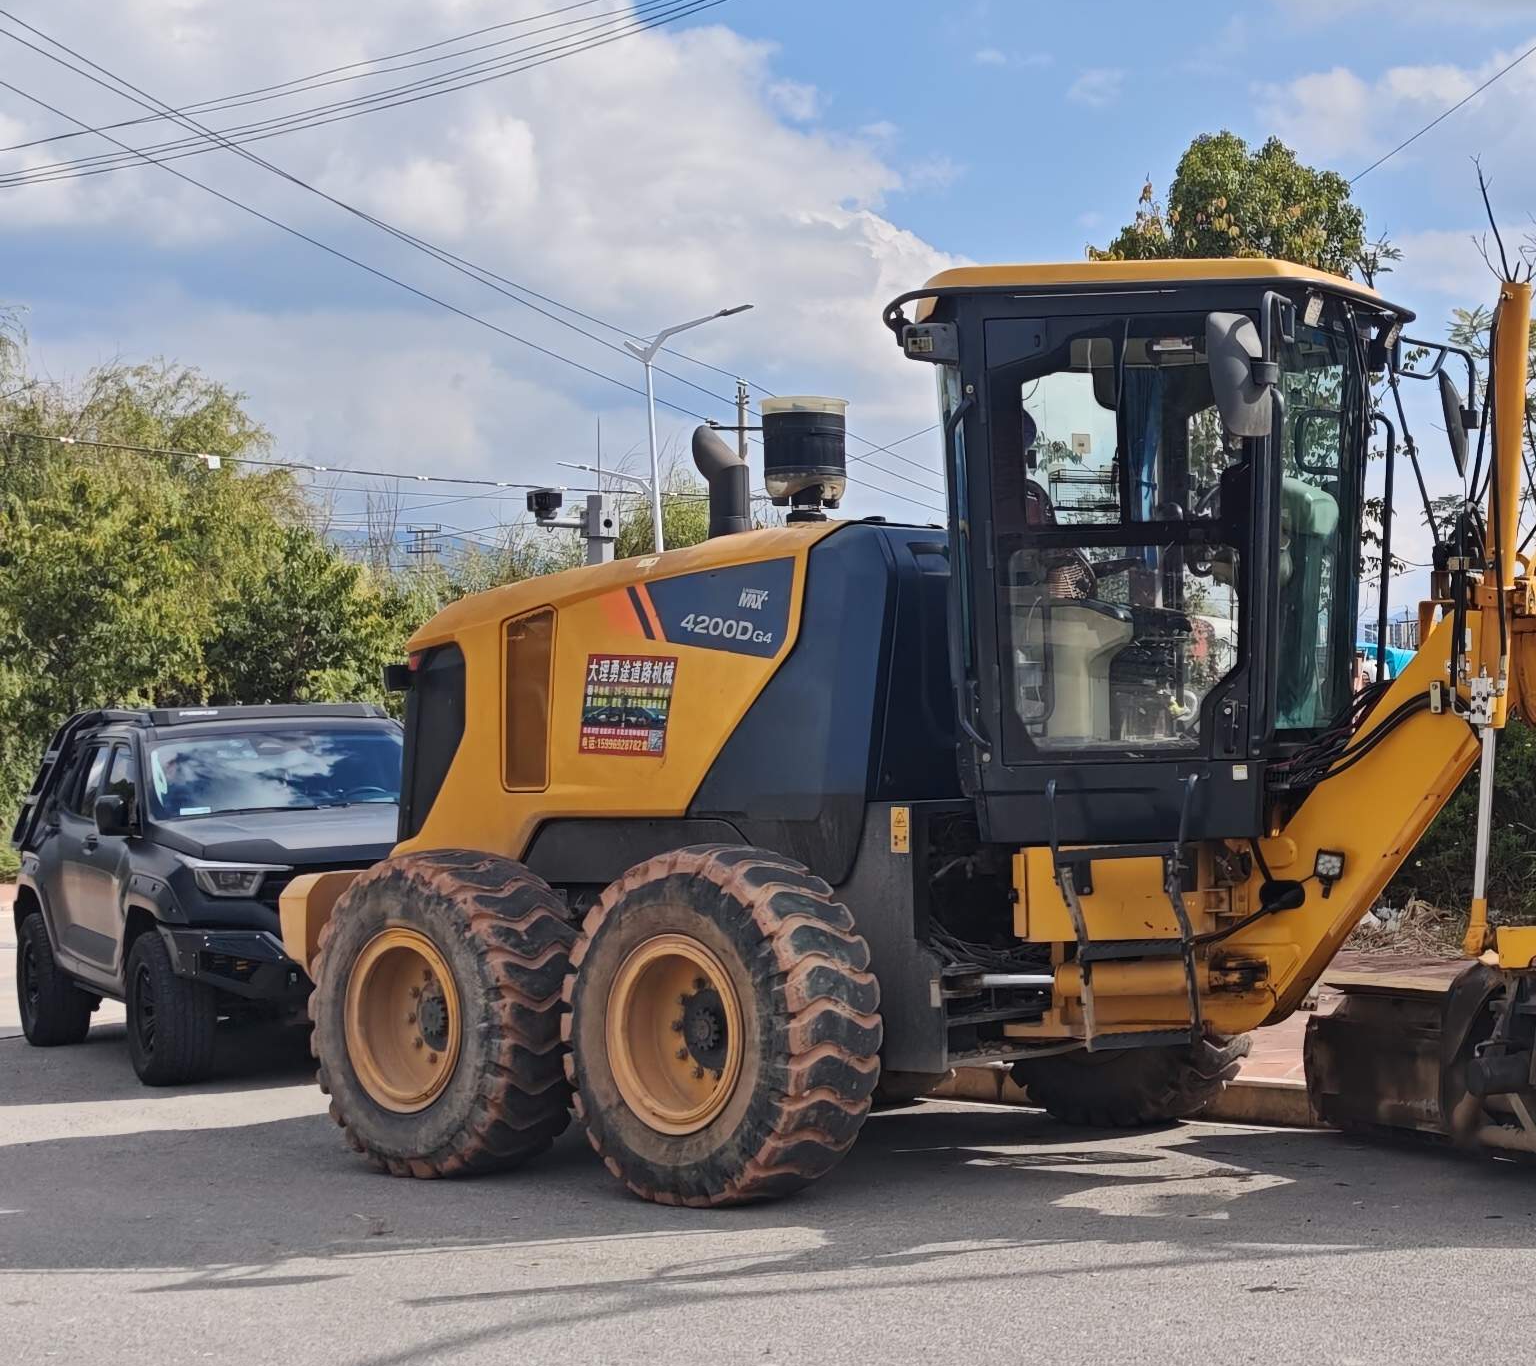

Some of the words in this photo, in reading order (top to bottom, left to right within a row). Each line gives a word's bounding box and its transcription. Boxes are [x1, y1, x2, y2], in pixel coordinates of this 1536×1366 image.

[738, 591, 768, 610] MAX
[588, 658, 675, 685] 大理勇途道路机械
